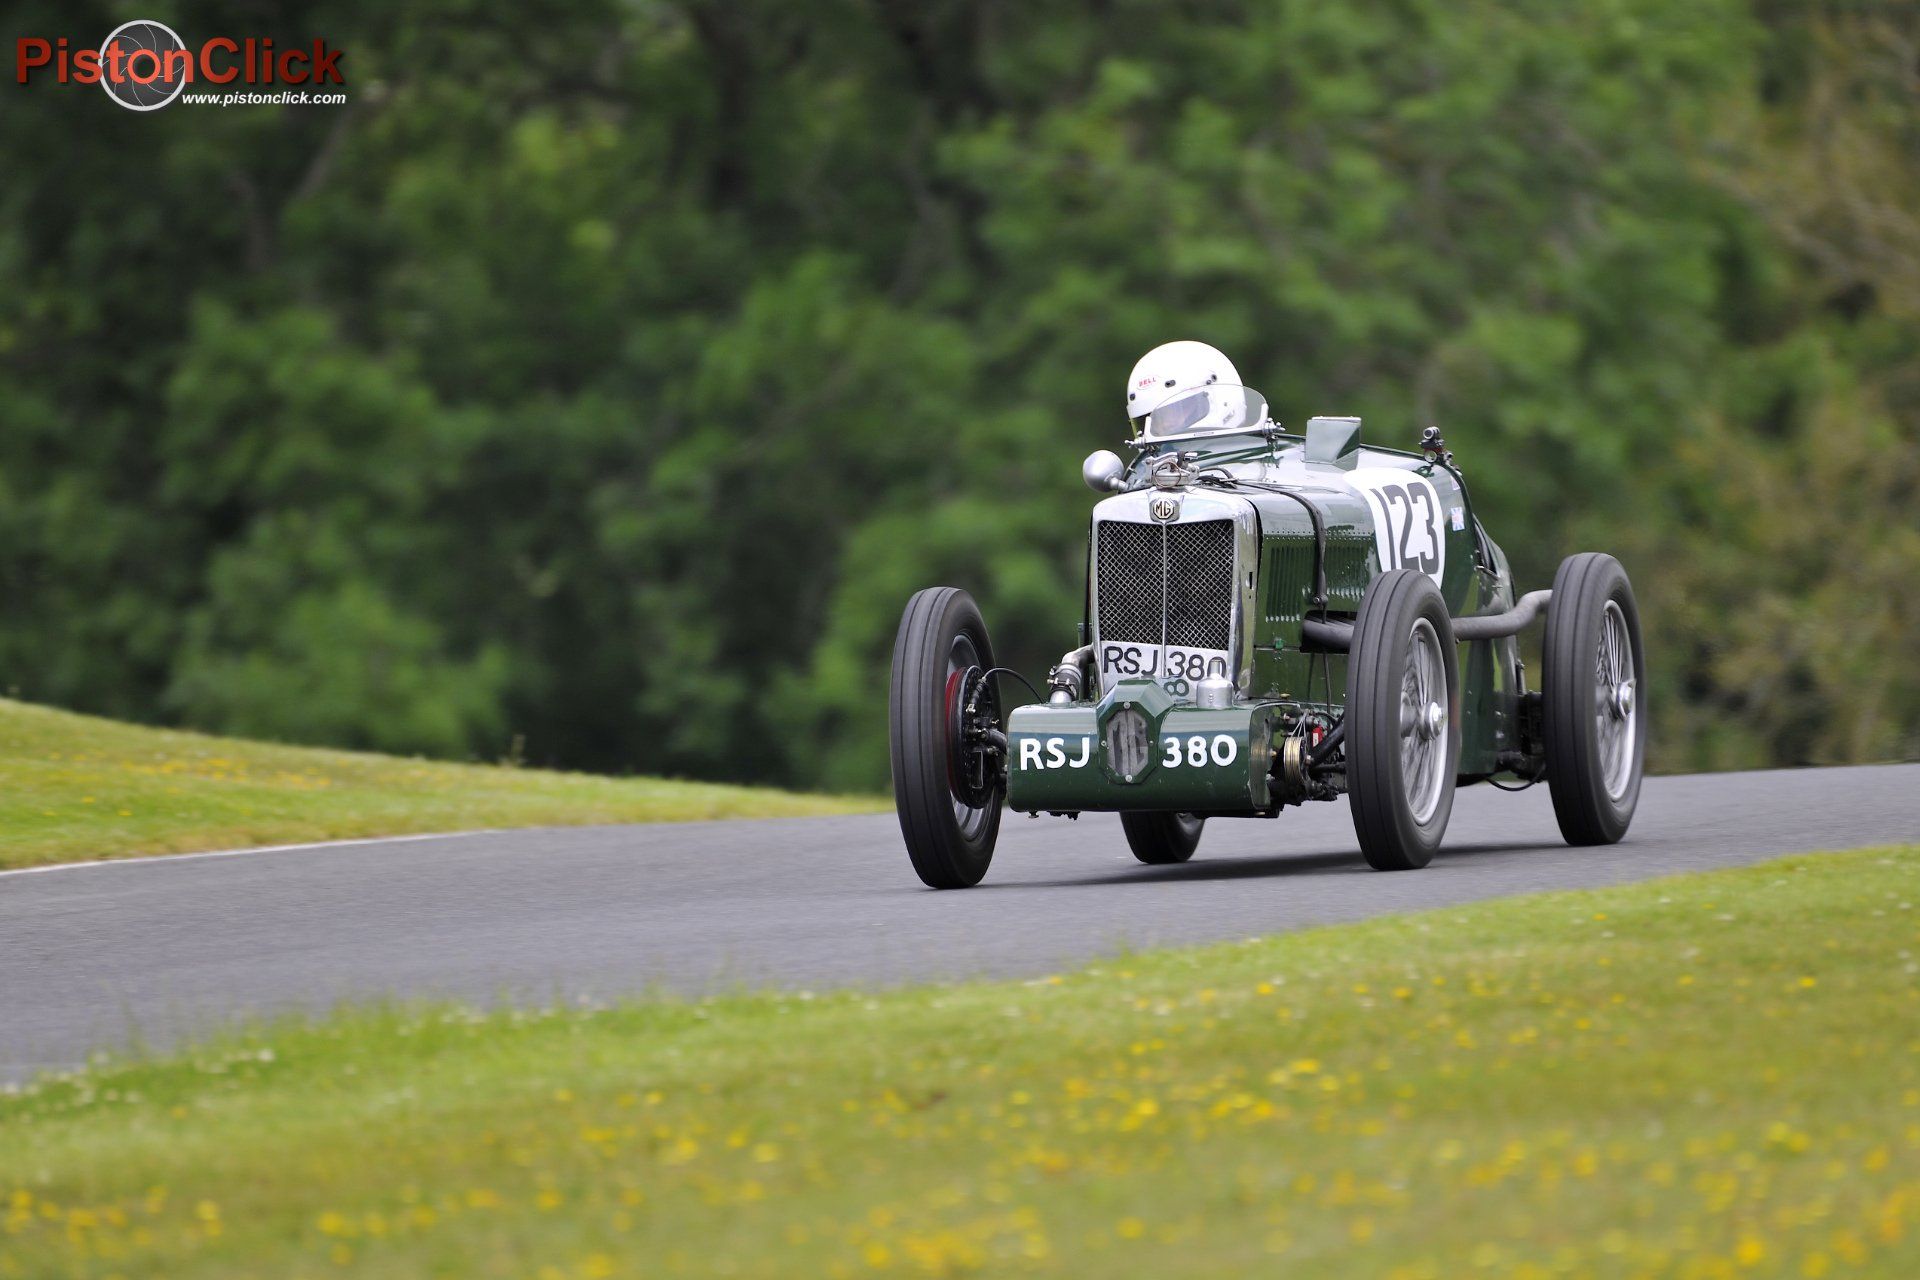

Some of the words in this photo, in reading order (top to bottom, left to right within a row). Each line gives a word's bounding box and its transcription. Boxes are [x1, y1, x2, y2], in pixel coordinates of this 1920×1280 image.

[1155, 500, 1172, 517] MG
[1369, 482, 1439, 574] 123
[1103, 646, 1158, 676] RSJ
[1019, 737, 1090, 771] RSJ
[1162, 734, 1238, 769] 380
